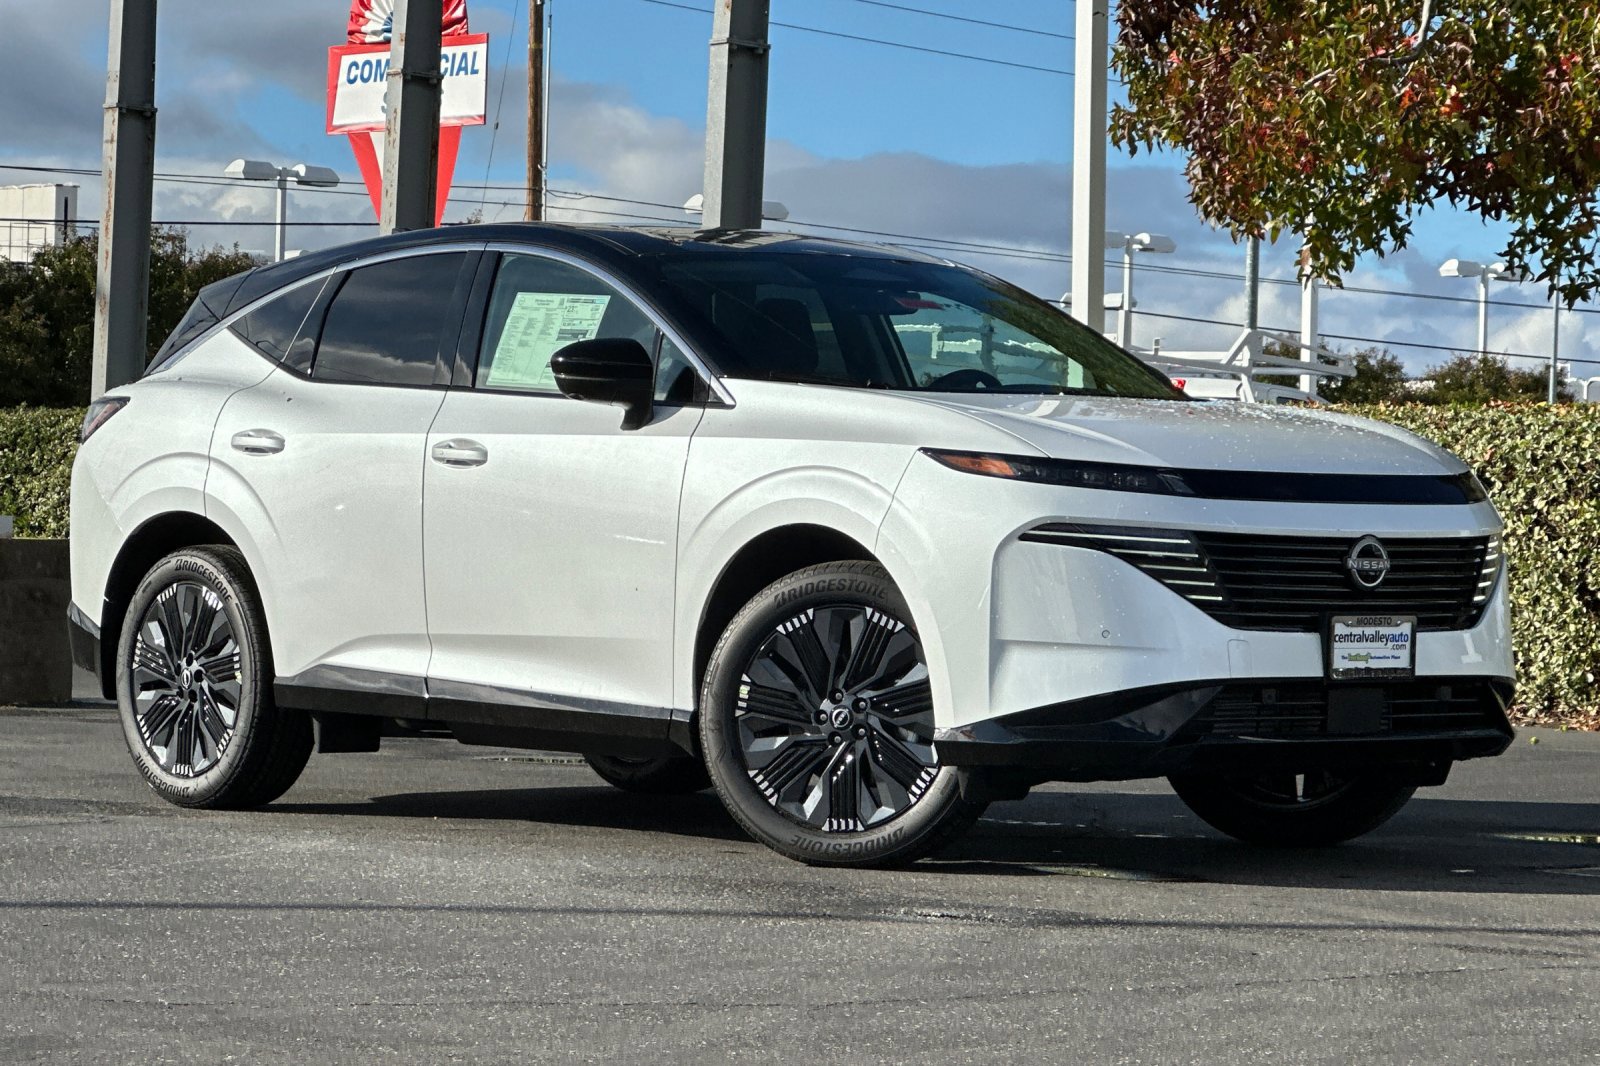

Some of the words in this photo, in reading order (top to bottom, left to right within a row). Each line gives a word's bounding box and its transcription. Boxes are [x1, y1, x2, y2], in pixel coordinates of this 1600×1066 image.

[1349, 560, 1390, 569] NISSAN
[175, 559, 232, 602] BRIDGESTONE
[774, 578, 888, 608] BRIDGESTONE
[1356, 617, 1392, 626] MODESTO
[1334, 630, 1409, 646] centralvalleyauto
[134, 752, 190, 798] BRIDGESTONE
[788, 826, 905, 854] BRIDGESTONE
